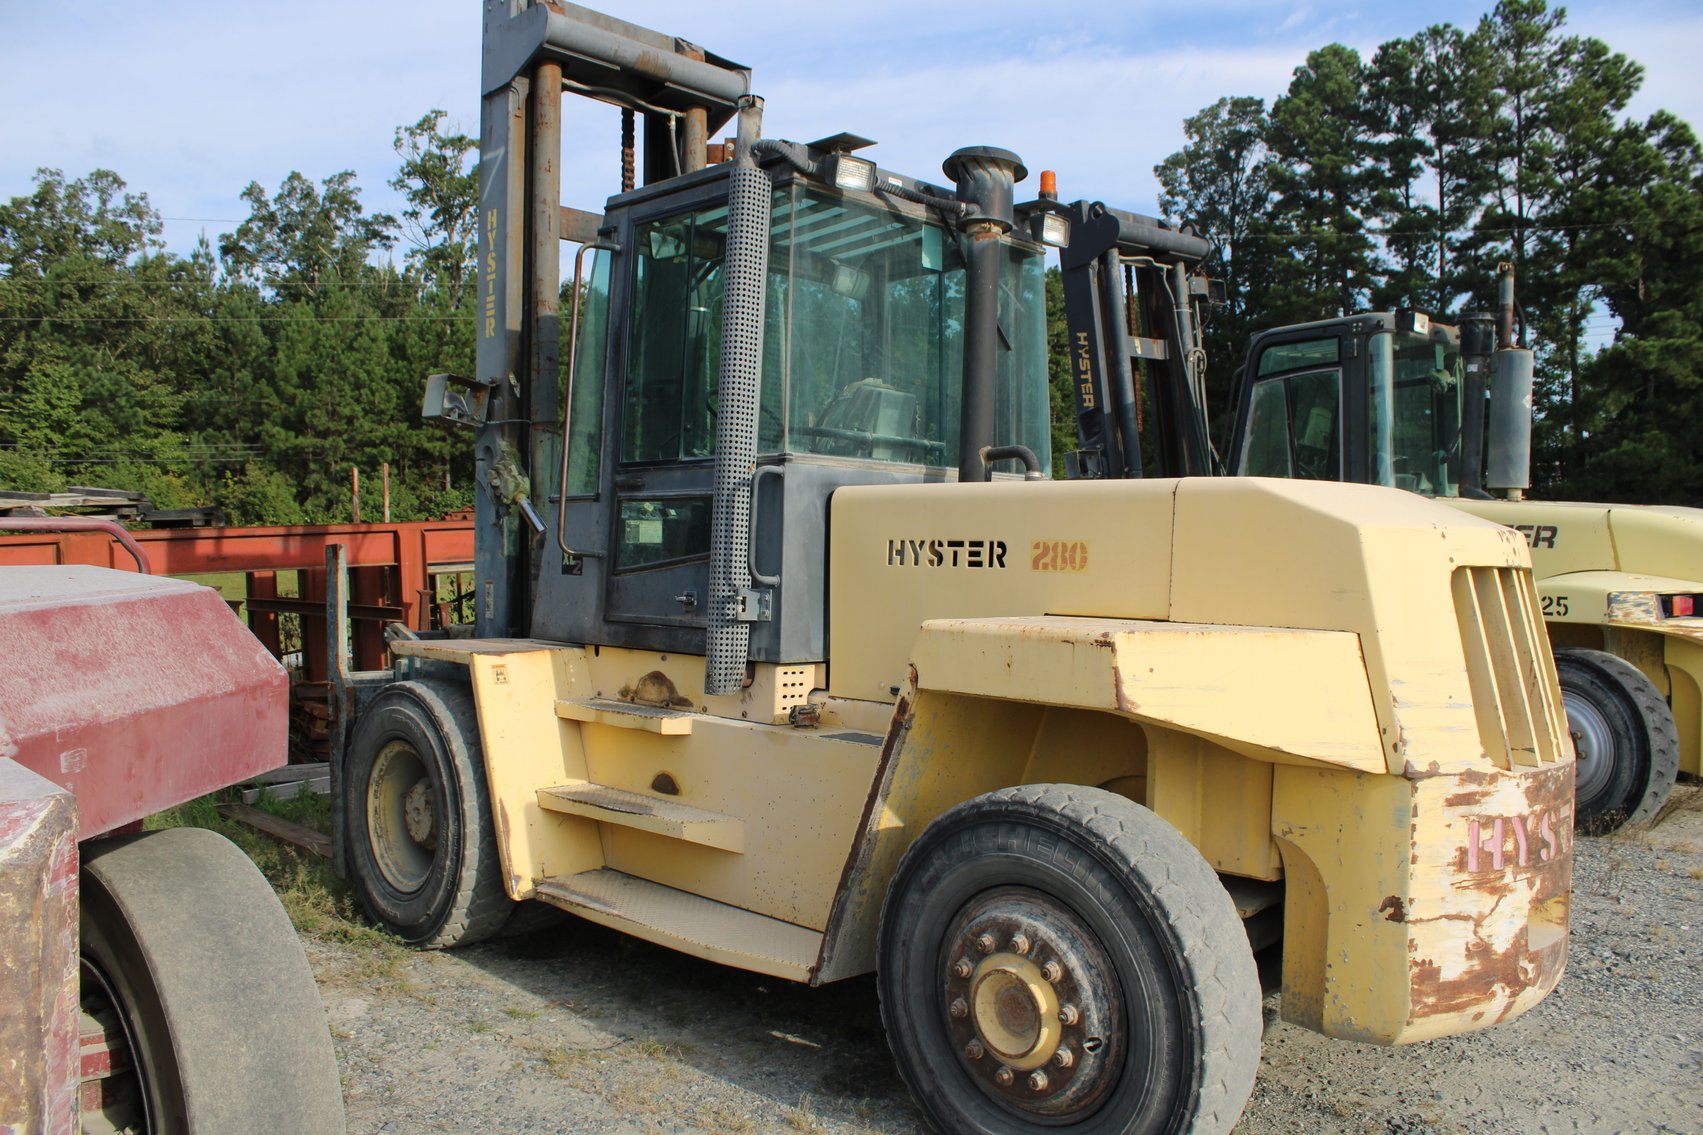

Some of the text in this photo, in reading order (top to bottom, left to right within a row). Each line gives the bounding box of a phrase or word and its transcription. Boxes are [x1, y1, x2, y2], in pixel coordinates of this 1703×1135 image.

[485, 208, 498, 338] HYSTER
[1076, 331, 1095, 408] HYSTER
[887, 539, 1089, 571] HYSTER 280
[1541, 596, 1569, 617] 25
